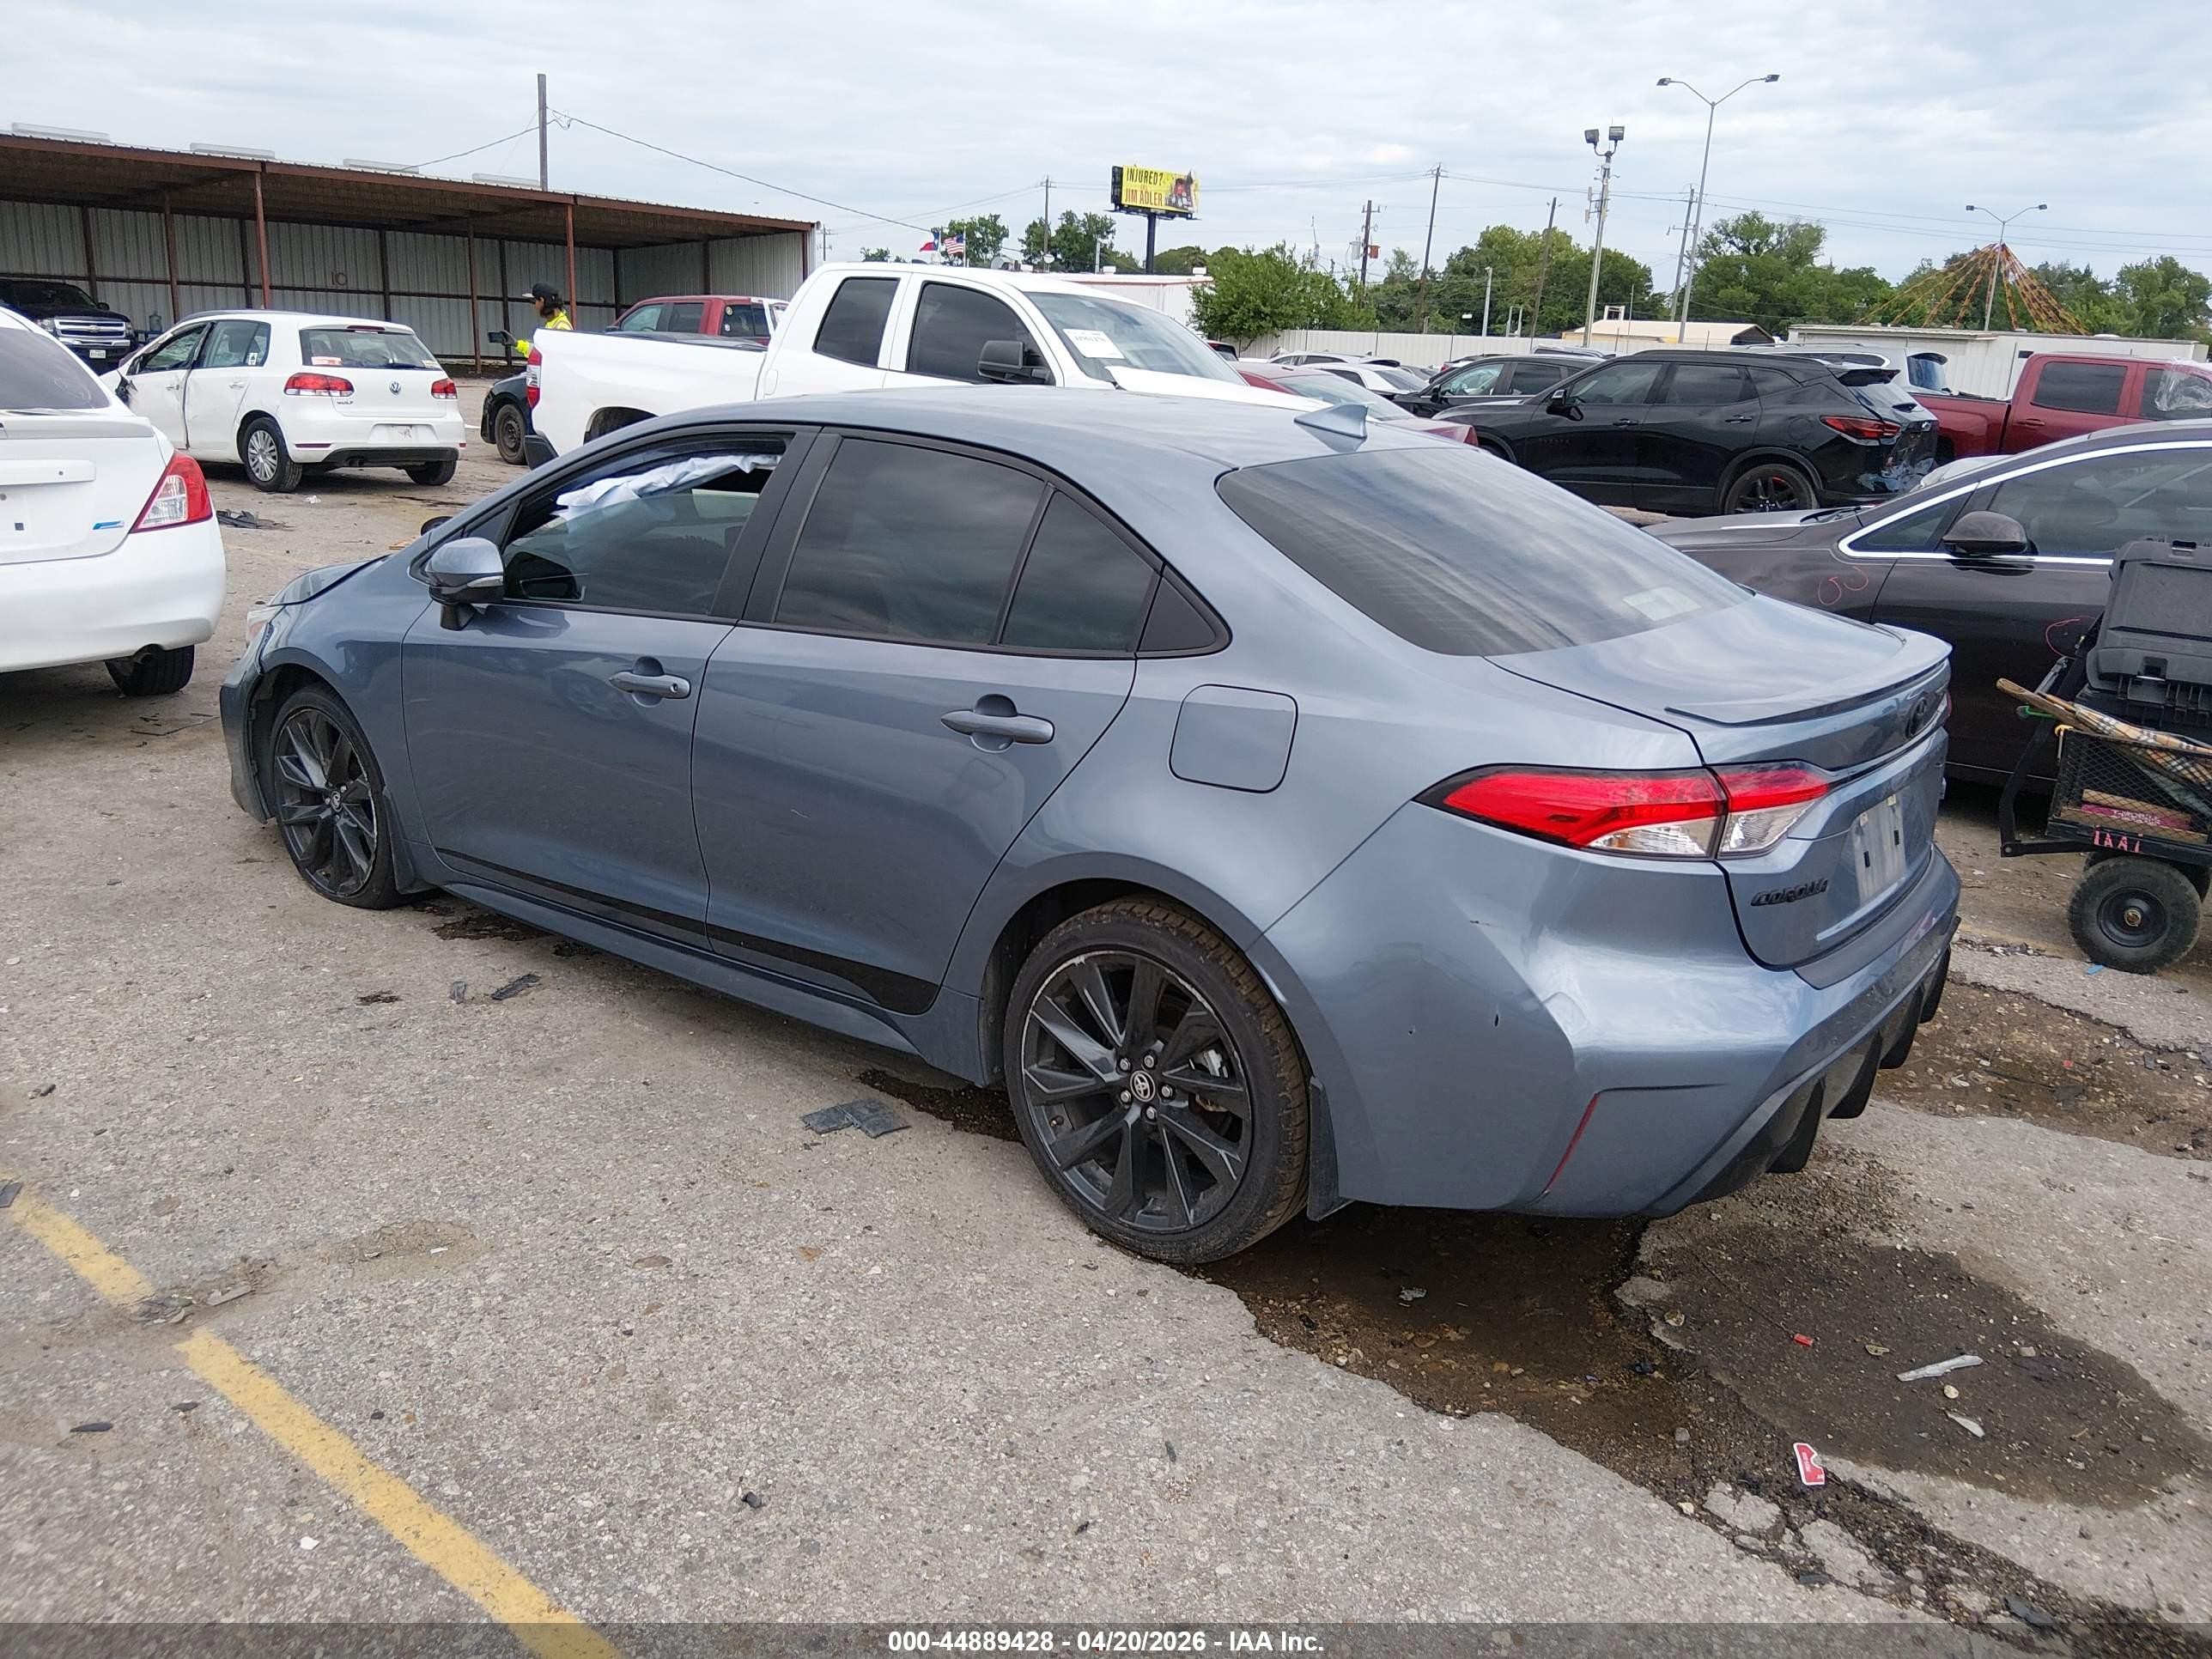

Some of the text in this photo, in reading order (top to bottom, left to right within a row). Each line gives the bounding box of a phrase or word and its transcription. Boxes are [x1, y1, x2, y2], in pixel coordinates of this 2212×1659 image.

[1127, 167, 1164, 185] INJURED?
[1125, 188, 1163, 206] JIM ADLER
